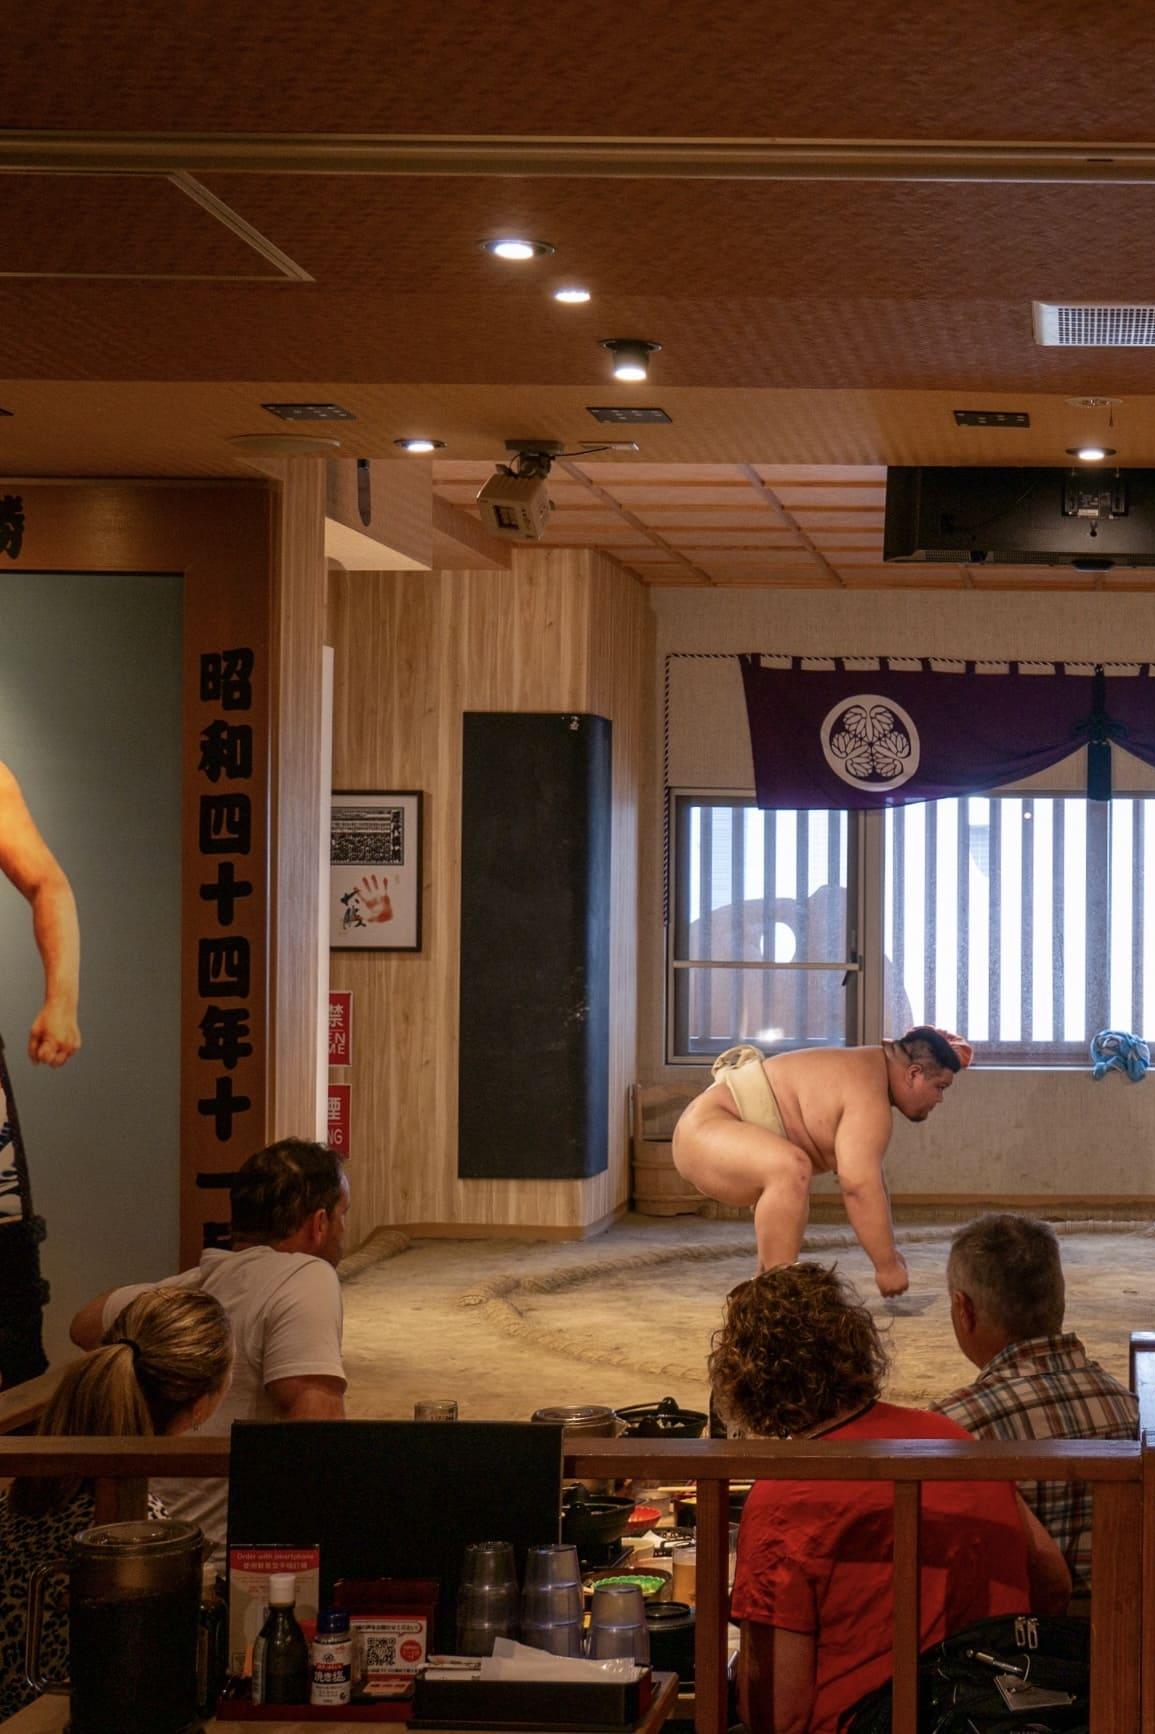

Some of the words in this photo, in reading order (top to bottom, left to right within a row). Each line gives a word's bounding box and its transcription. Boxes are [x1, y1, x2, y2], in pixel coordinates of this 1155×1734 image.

[197, 647, 254, 1250] 昭和四十四年十一
